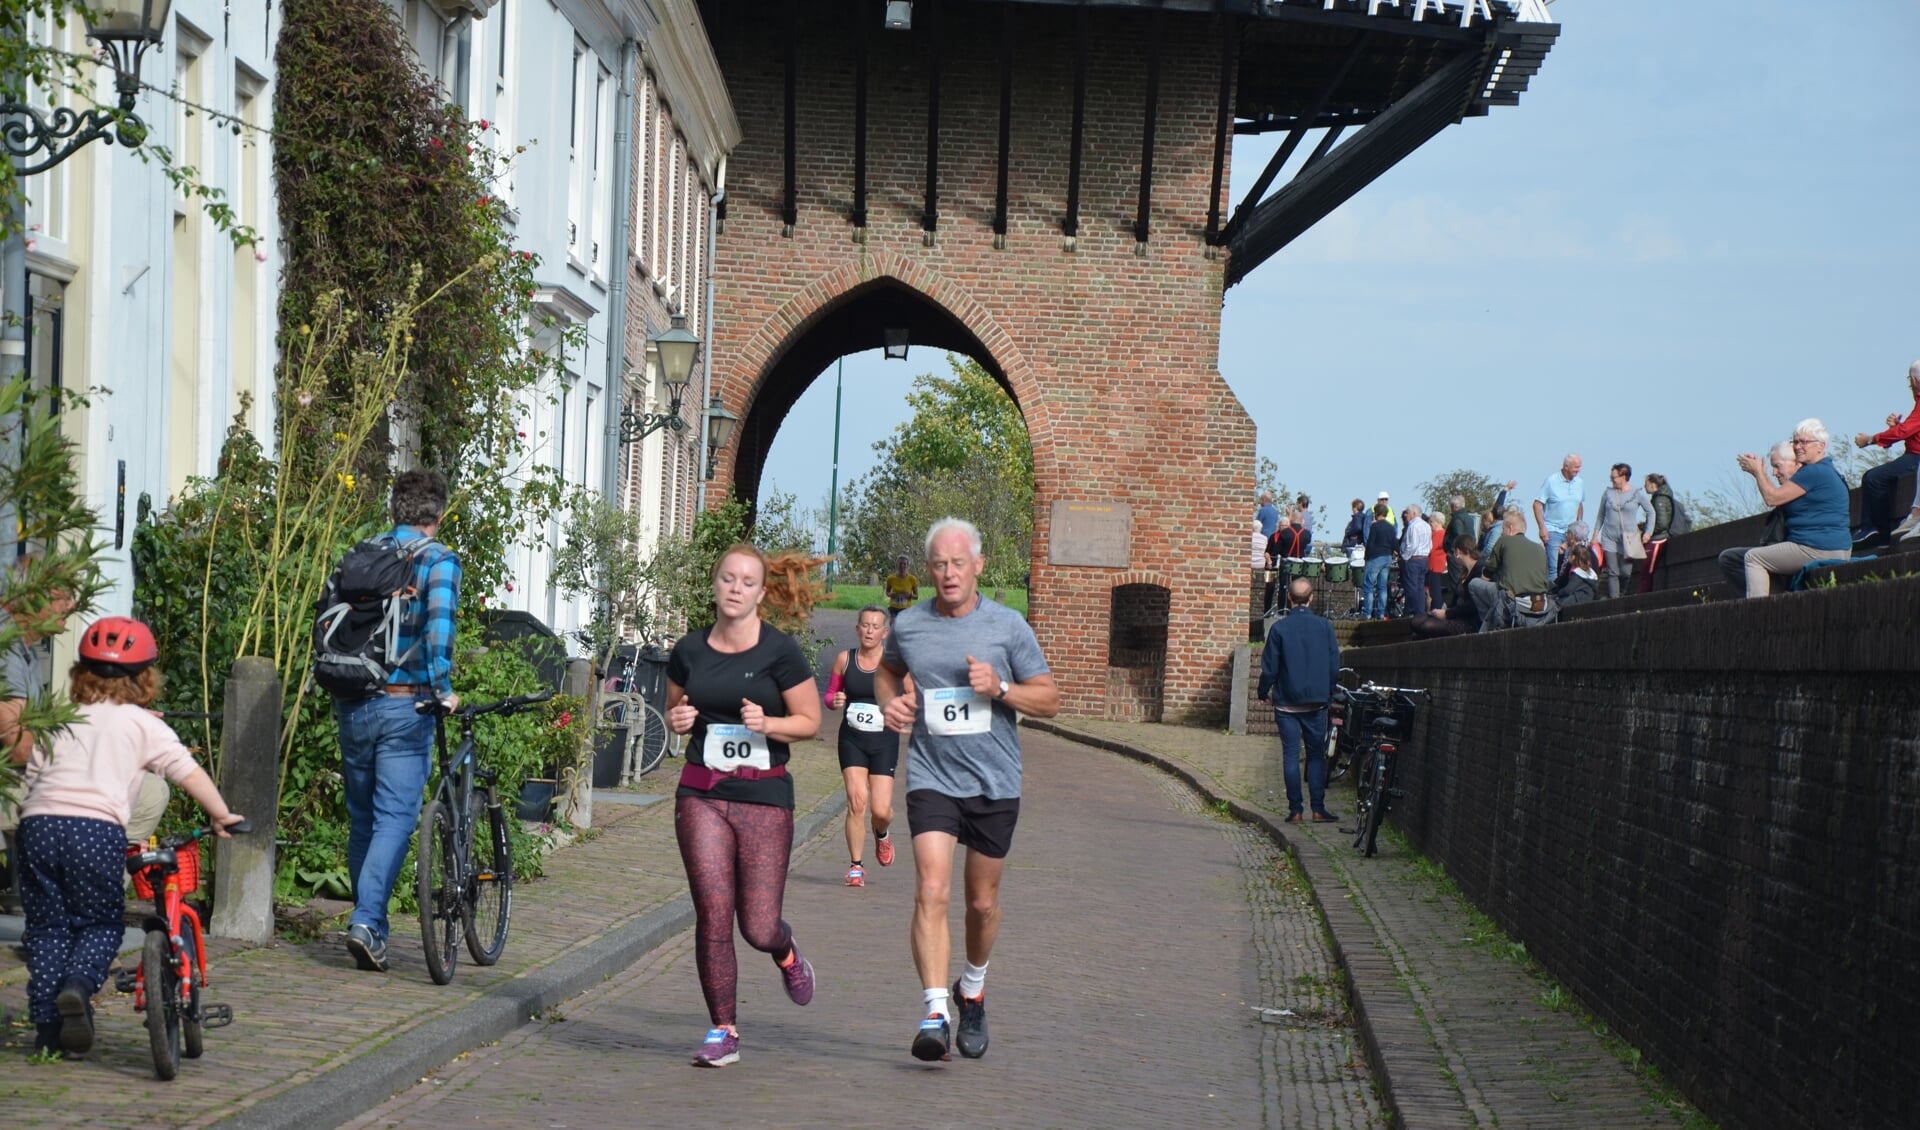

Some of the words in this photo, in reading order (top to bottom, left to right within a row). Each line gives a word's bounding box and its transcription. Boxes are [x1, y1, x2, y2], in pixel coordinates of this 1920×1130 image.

[856, 712, 874, 724] 62
[943, 703, 969, 721] 61
[723, 741, 751, 758] 60
